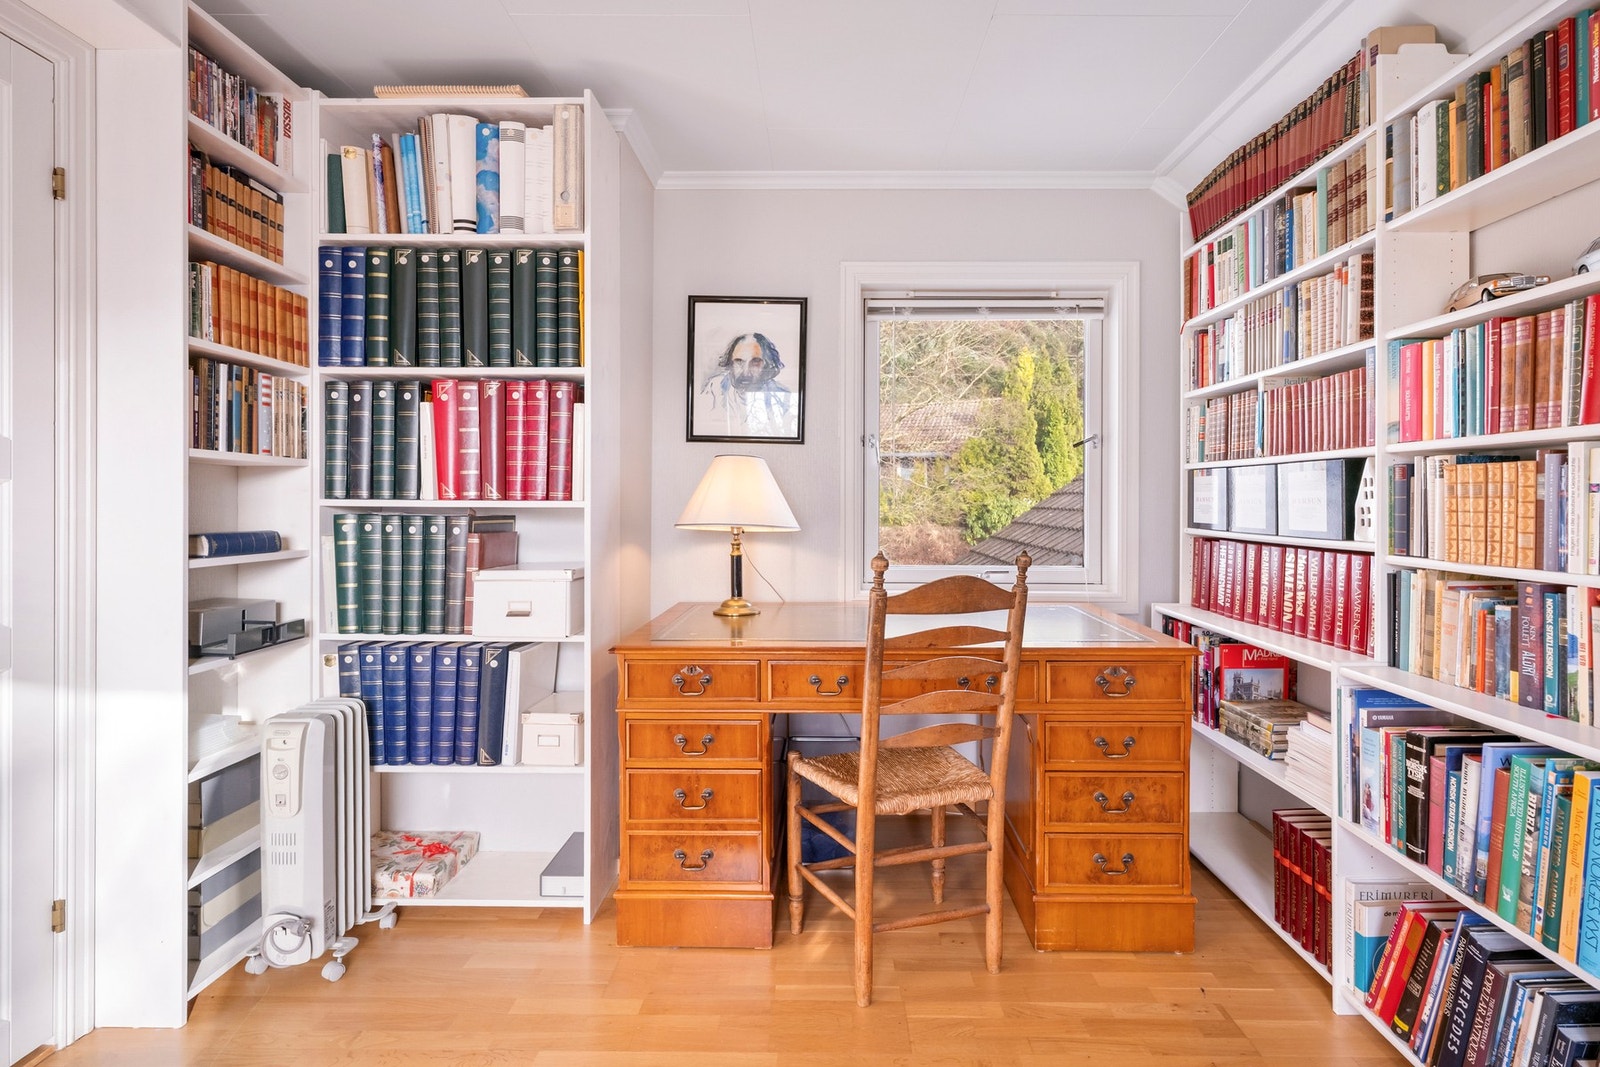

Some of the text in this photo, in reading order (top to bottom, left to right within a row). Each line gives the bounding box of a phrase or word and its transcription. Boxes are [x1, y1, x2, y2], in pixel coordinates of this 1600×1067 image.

[282, 98, 291, 139] RUSSIA
[1217, 545, 1226, 606] HEMINGWAY
[1225, 568, 1233, 607] STEINBECK
[1258, 550, 1269, 617] GRAHAM GREENE
[1284, 552, 1296, 623] SIMENON
[1295, 554, 1307, 617] Morris West
[1308, 557, 1318, 631] WILBUR SMITH
[1336, 560, 1346, 636] NEVIL SHUTE
[1351, 582, 1362, 642] LAWRENCE
[1521, 616, 1537, 649] KEN FOLLETT
[1545, 598, 1554, 679] NORSK SITATLEKSIKON
[1244, 649, 1286, 661] MADR
[1521, 650, 1537, 678] ALDRI
[1446, 776, 1457, 852] NORSK SITATLEKSIKON
[1510, 764, 1520, 818] SOUTH AFRICA
[1513, 768, 1527, 861] ILLUSTRATED HISTORY OF
[1556, 808, 1565, 834] ALAN
[1542, 817, 1550, 846] VERDEN
[1571, 808, 1584, 868] Marc Chagall
[1359, 889, 1434, 901] FRIMURERI
[1547, 871, 1559, 918] GAMBLING
[1587, 850, 1600, 911] NORGES
[1451, 936, 1466, 978] PANORAMA
[1584, 915, 1600, 953] KYST
[1448, 977, 1457, 992] VAN
[1447, 974, 1474, 1056] MERCEDES
[1466, 968, 1494, 1065] POPULAR ANTIQUES
